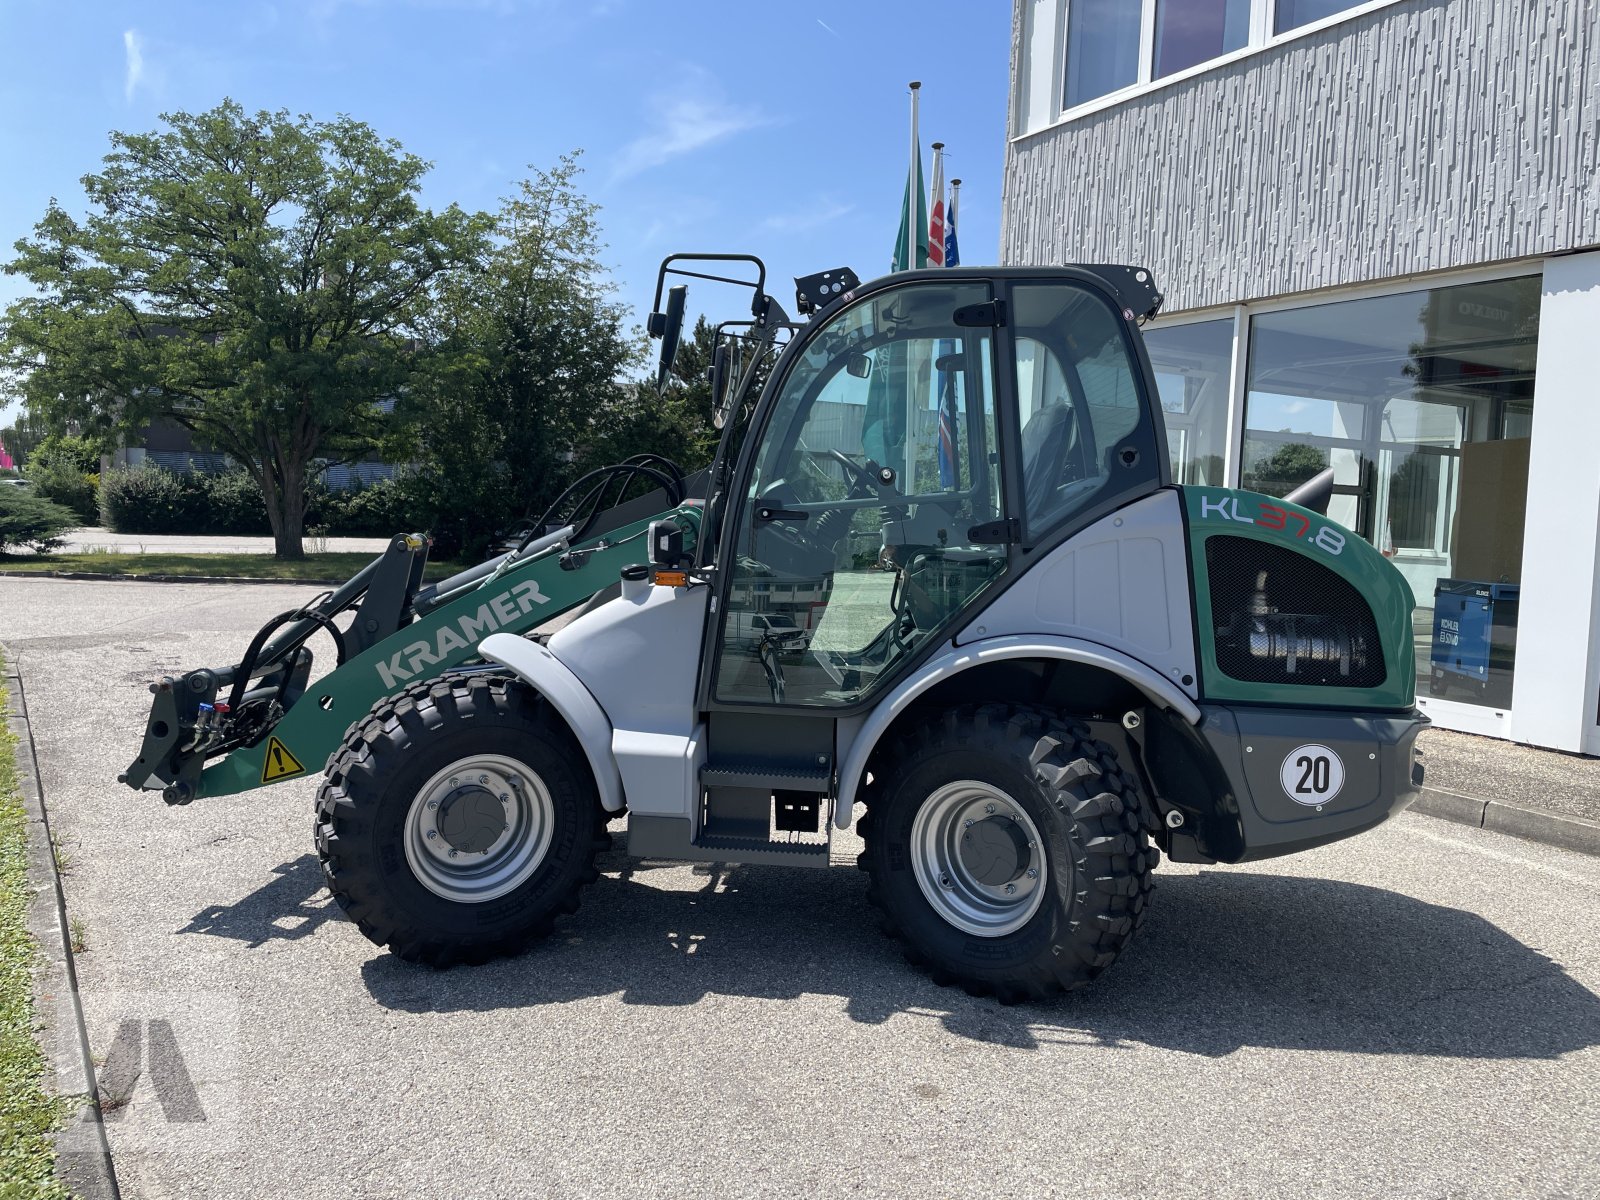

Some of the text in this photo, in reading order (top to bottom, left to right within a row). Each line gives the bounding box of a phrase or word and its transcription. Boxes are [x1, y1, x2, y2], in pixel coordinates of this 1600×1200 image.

[1202, 495, 1346, 556] KL37.8
[375, 579, 551, 690] KRAMER
[1441, 619, 1459, 631] KOHLER
[1295, 755, 1331, 794] 20
